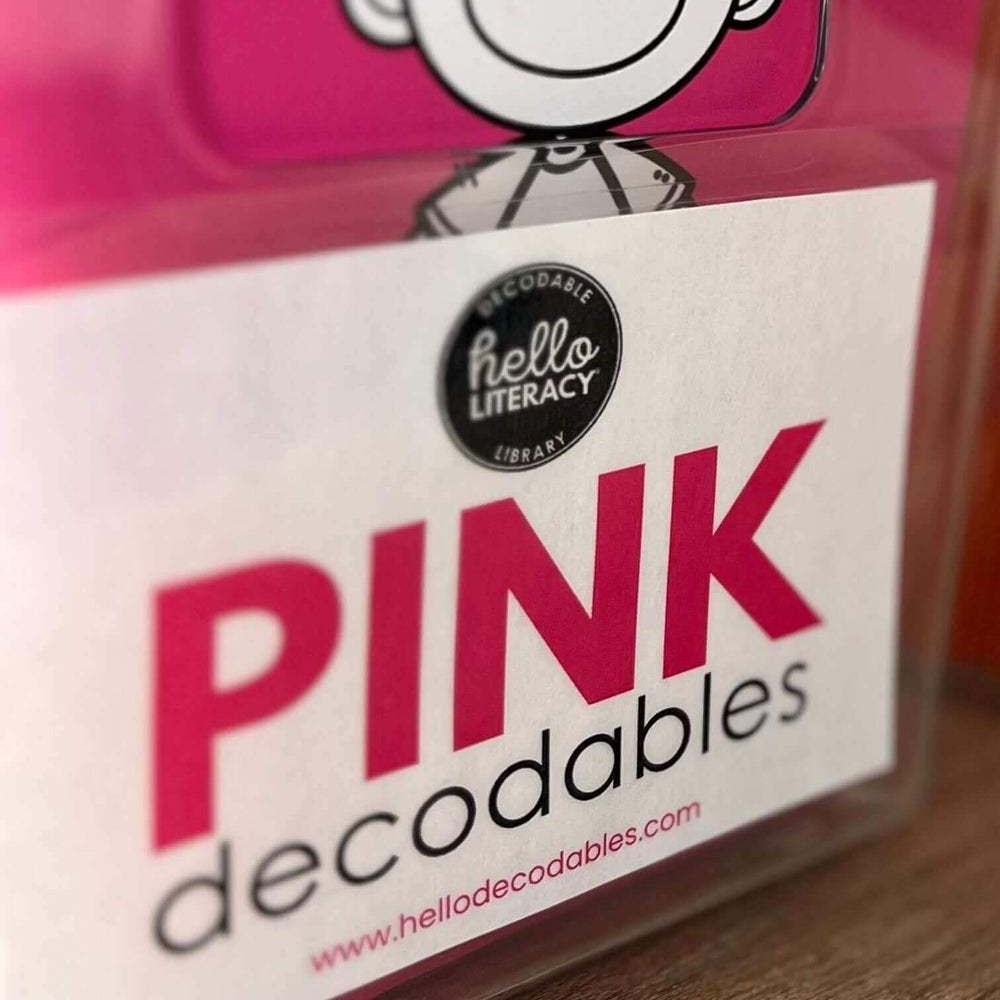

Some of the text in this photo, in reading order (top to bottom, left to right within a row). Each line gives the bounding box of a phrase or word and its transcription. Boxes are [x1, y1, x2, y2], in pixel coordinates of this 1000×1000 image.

[467, 317, 600, 391] hello
[468, 369, 597, 421] LITERACY
[494, 431, 567, 463] LIBRARY
[149, 418, 827, 857] PINK
[150, 660, 810, 955] decodables
[310, 800, 702, 973] www.hellodecodables.com
